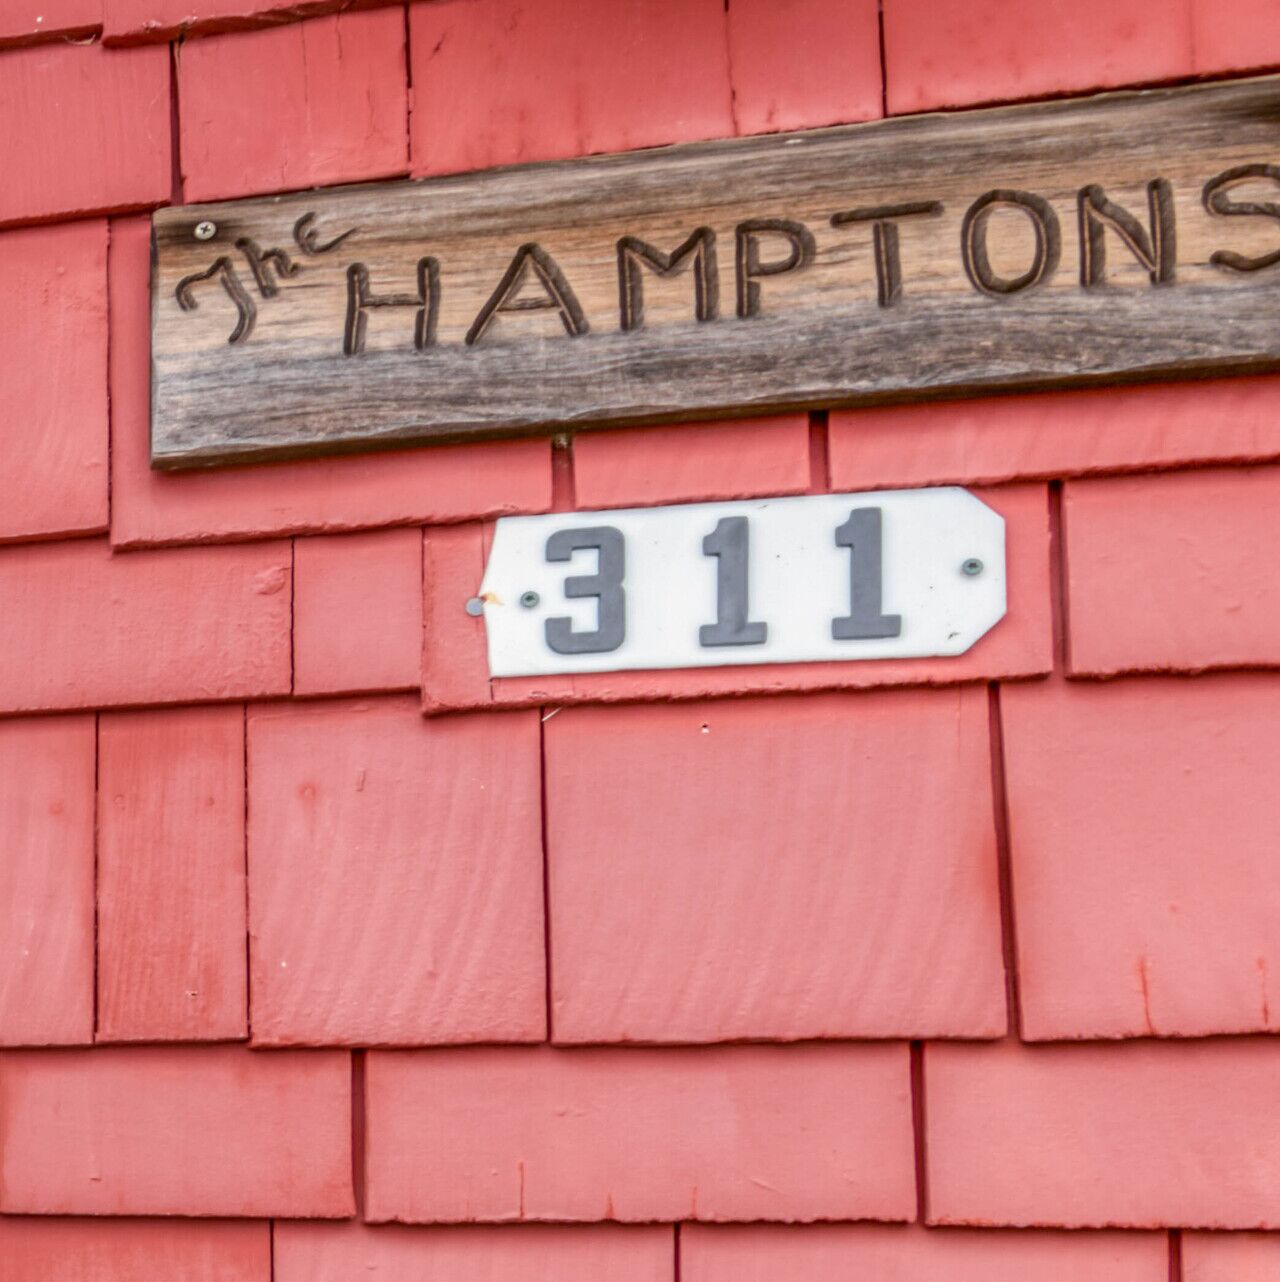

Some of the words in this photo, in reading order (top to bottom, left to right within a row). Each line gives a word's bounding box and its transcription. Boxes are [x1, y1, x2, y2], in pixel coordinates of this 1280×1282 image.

[174, 210, 361, 346] The
[342, 162, 1280, 357] HAMPTONS
[545, 506, 902, 656] 311
